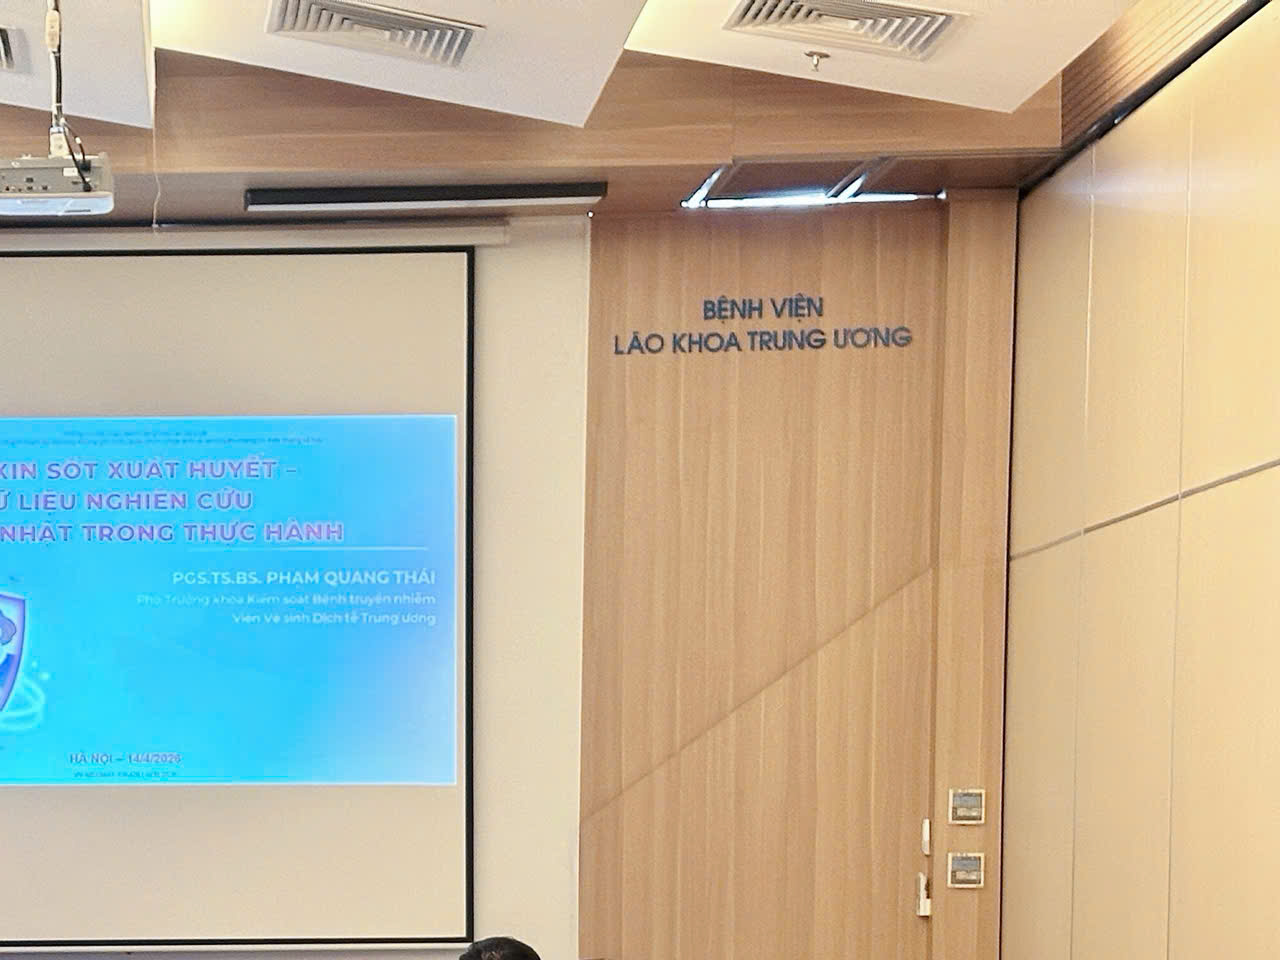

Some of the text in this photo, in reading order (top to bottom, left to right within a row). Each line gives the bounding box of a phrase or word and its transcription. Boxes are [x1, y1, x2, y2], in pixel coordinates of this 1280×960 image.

[703, 293, 823, 323] BỆNH VIỆN
[614, 325, 913, 355] LÃO KHOA TRUNG ƯƠNG
[20, 489, 76, 515] LIỆU
[87, 488, 186, 510] NGHIÊN
[82, 525, 174, 542] TRONG
[266, 519, 343, 541] HÀNH
[173, 571, 262, 585] PGS.TS.BS.
[324, 571, 389, 586] QUANG
